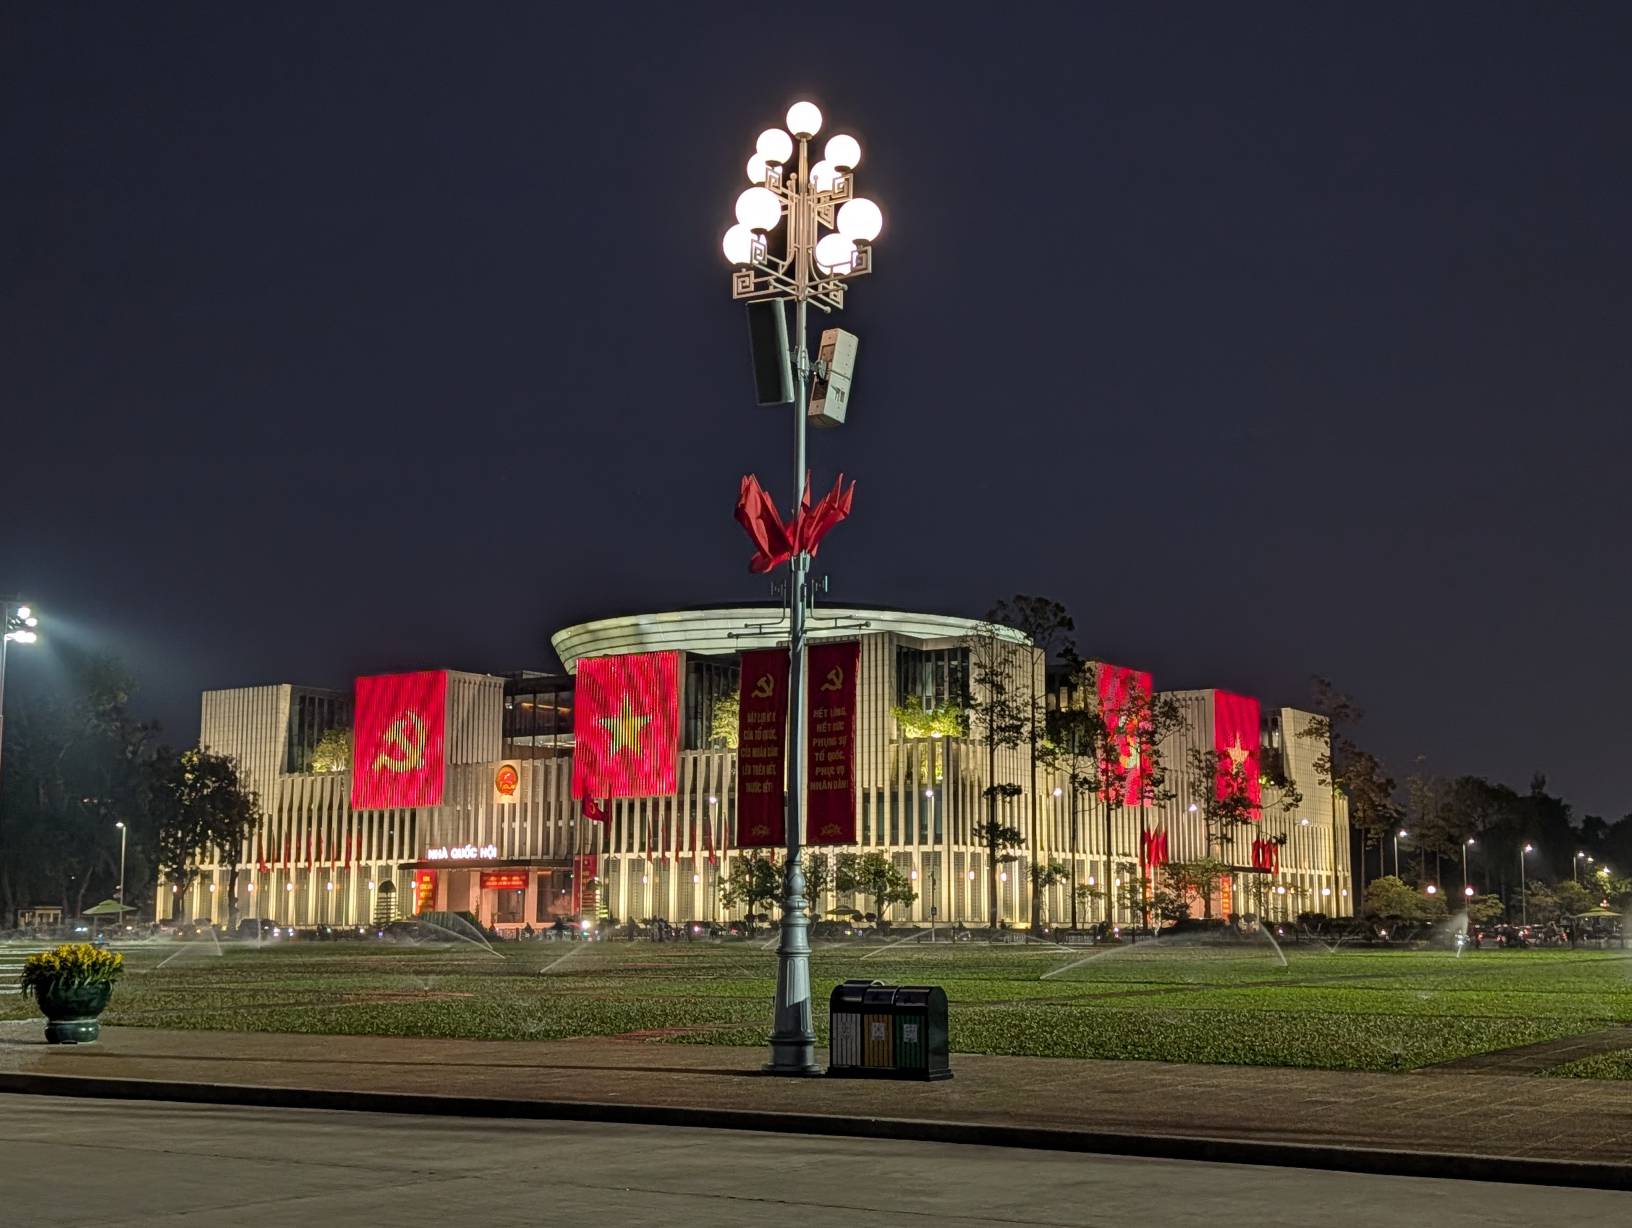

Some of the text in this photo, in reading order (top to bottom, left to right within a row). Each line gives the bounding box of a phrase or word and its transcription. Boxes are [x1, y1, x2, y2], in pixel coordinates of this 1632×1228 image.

[813, 707, 828, 718] HẾT
[816, 721, 832, 732] HẾT
[812, 735, 848, 748] PHỤNG SỰ
[814, 748, 824, 762] TỔ
[816, 765, 845, 777] PHỤC VỤ
[810, 780, 832, 790] NHÂN
[428, 844, 497, 859] NHÀ QUỐC HỘI
